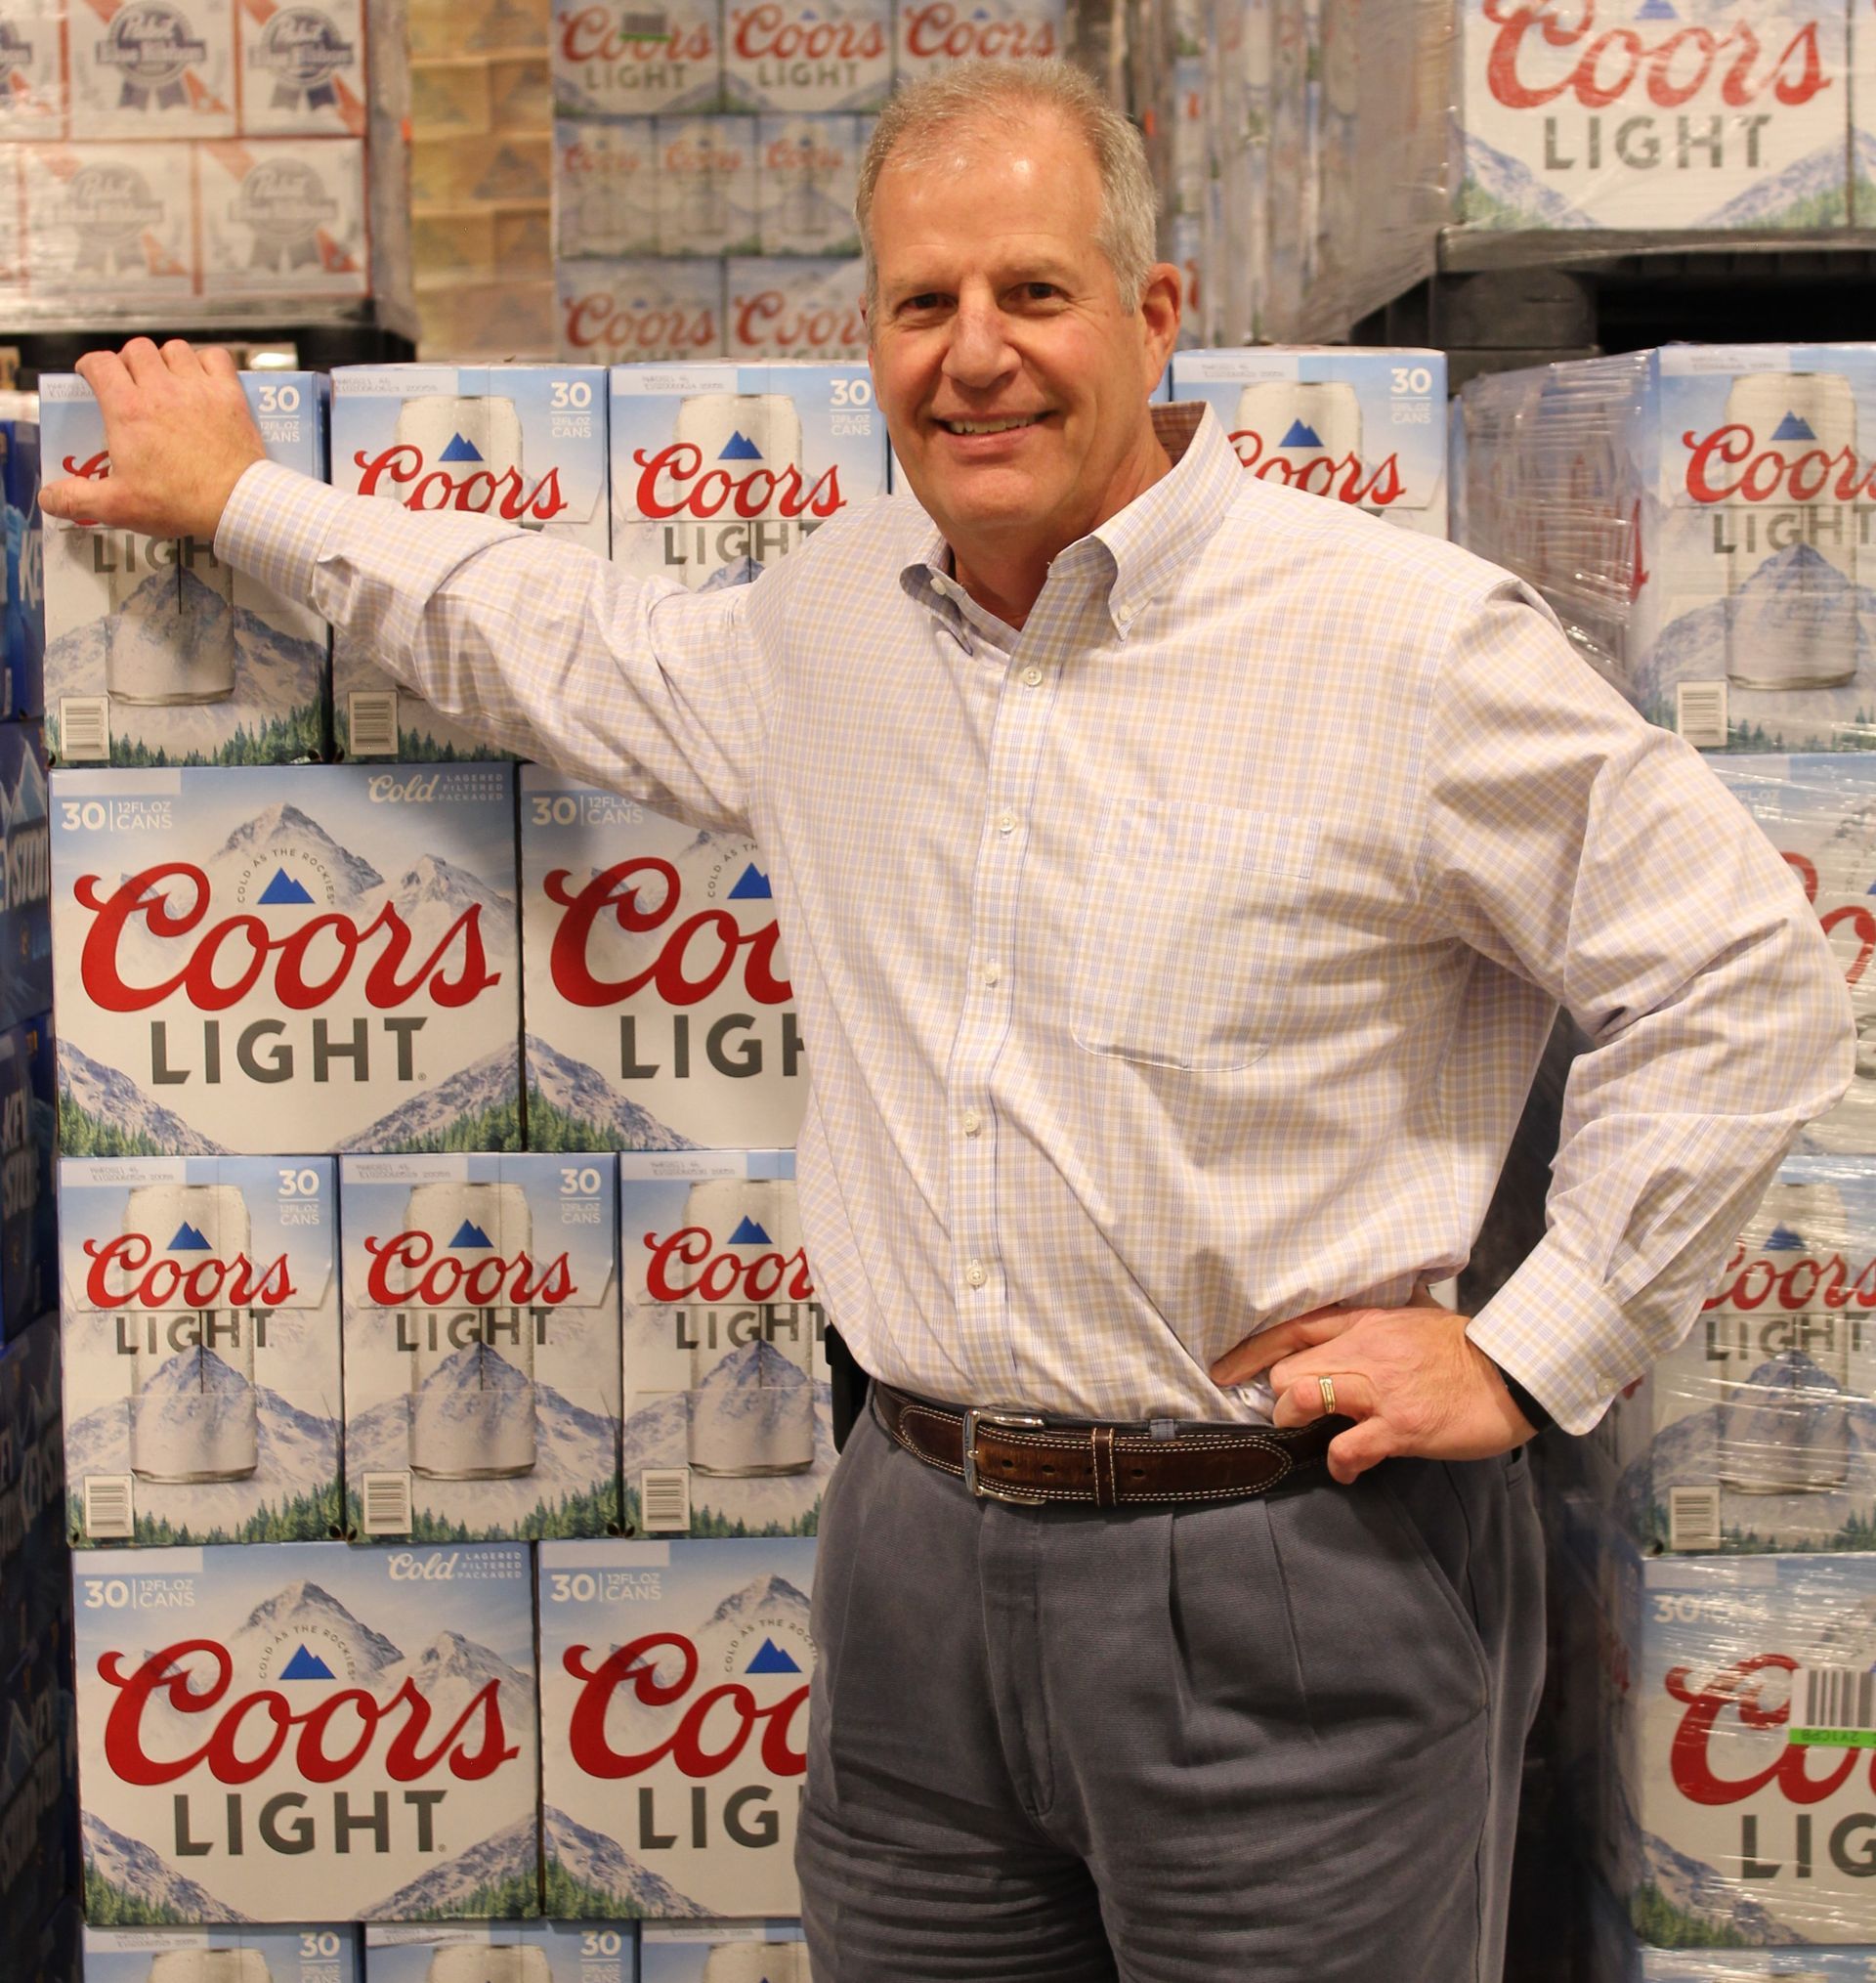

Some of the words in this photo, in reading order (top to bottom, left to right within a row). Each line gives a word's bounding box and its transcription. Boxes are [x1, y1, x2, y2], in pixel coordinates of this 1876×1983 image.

[731, 4, 885, 59] Coors
[904, 1, 1056, 57] Coors
[1482, 0, 1832, 108] Coors
[586, 63, 687, 89] LIGHT
[757, 62, 860, 86] LIGHT
[1545, 114, 1772, 170] LIGHT
[563, 292, 715, 348] Coors
[550, 381, 591, 408] 30
[830, 379, 872, 406] 30
[1390, 367, 1432, 394] 30
[258, 386, 300, 411] 30
[831, 424, 872, 436] CANS
[1391, 412, 1431, 424] CANS
[551, 427, 591, 438] CANS
[633, 443, 847, 519] Coors
[1714, 504, 1876, 553] LIGHT
[368, 774, 441, 803] Cold
[62, 801, 107, 831] 30
[117, 801, 172, 813] 12FL.OZ
[532, 797, 576, 826] 30
[587, 809, 644, 825] CANS
[116, 814, 173, 830] CANS
[237, 870, 252, 904] COLD
[253, 854, 267, 868] AS
[273, 847, 296, 857] THE
[708, 865, 722, 897] COLD
[724, 849, 738, 863] AS
[74, 862, 502, 1013] Coors
[150, 1016, 428, 1084] LIGHT
[277, 1170, 320, 1195] 30
[560, 1168, 601, 1194] 30
[279, 1214, 320, 1226] CANS
[561, 1212, 601, 1224] CANS
[83, 1233, 297, 1309] Coors
[364, 1230, 578, 1306] Coors
[116, 1310, 275, 1355] LIGHT
[397, 1307, 555, 1352] LIGHT
[388, 1552, 459, 1580] Cold
[84, 1579, 129, 1608] 30
[140, 1592, 195, 1608] CANS
[550, 1573, 595, 1602] 30
[606, 1585, 661, 1602] CANS
[1653, 1595, 1700, 1623] 30
[276, 1631, 289, 1645] AS
[294, 1625, 318, 1634] THE
[741, 1625, 755, 1638] AS
[759, 1618, 784, 1627] THE
[97, 1639, 521, 1786] Coors
[174, 1789, 448, 1856] LIGHT
[299, 1931, 340, 1957] 30
[580, 1931, 622, 1956] 30
